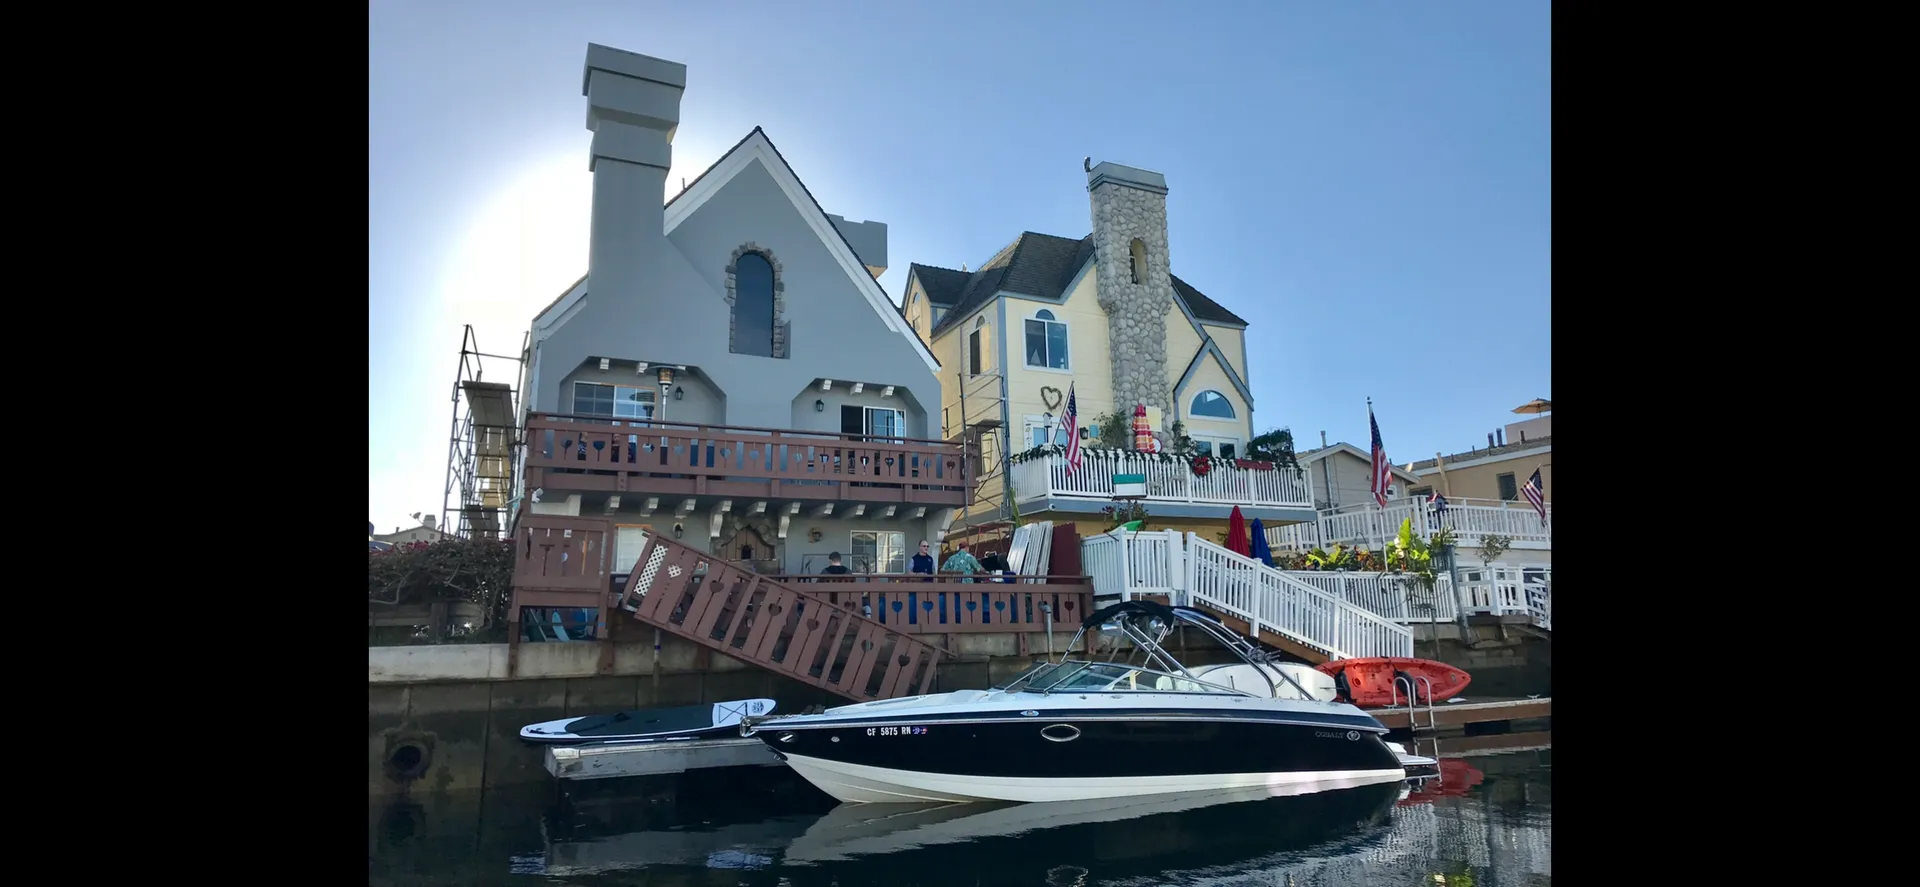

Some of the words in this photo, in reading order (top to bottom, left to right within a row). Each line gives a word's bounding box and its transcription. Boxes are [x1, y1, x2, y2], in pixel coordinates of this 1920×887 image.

[866, 727, 876, 736] CF
[880, 727, 898, 736] 5875
[901, 726, 911, 735] RN
[1315, 731, 1345, 739] COBALT
